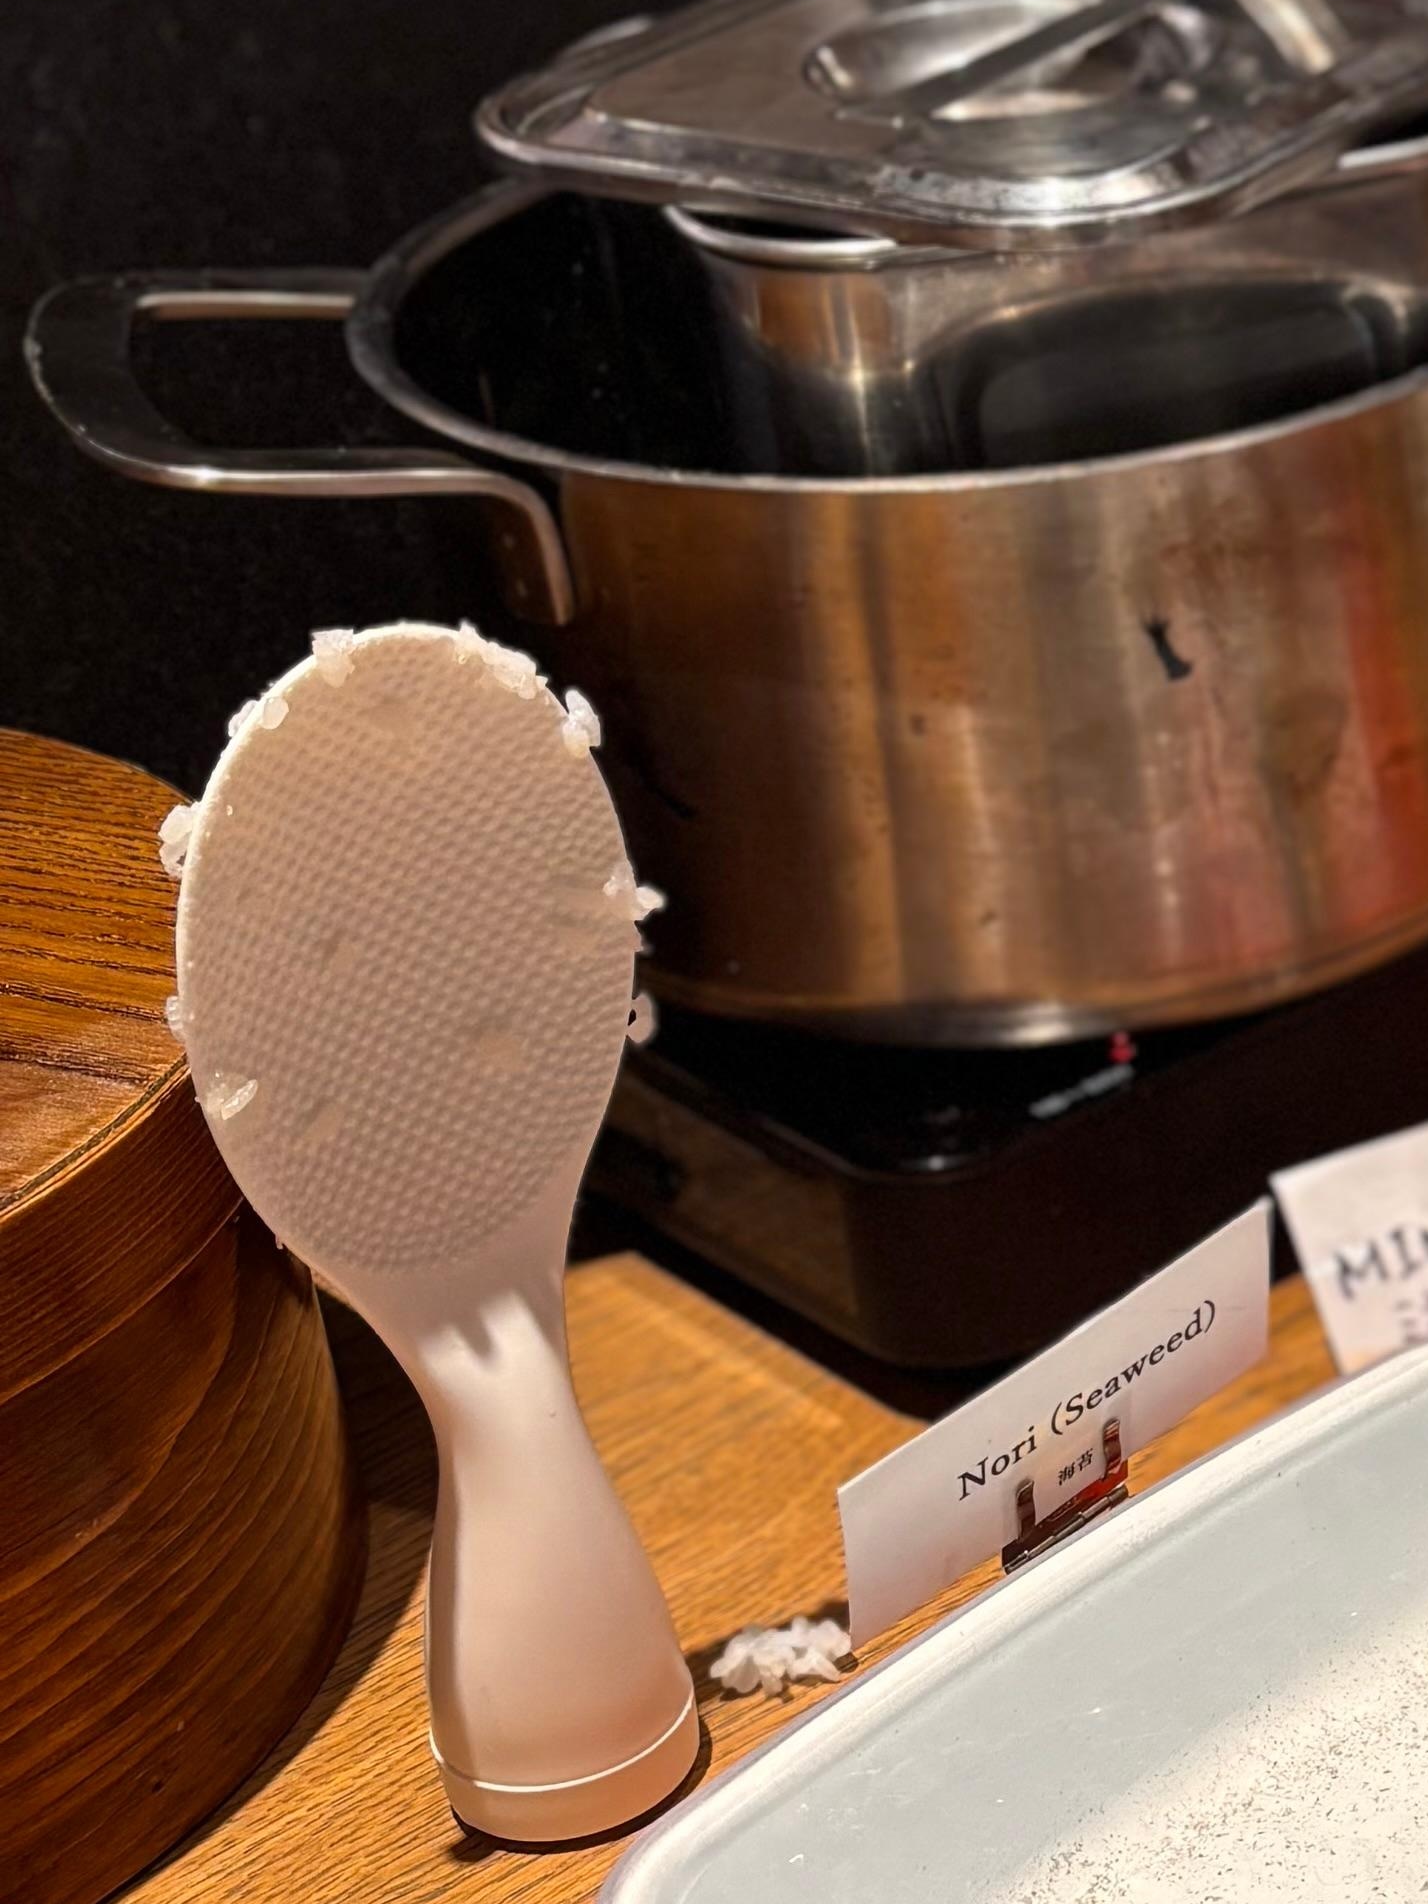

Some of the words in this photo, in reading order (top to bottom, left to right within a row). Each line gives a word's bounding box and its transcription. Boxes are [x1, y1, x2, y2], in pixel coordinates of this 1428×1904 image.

[957, 1425, 1037, 1501] Nori
[1050, 1299, 1216, 1436] (Seaweed)
[1057, 1447, 1095, 1486] 海苔
